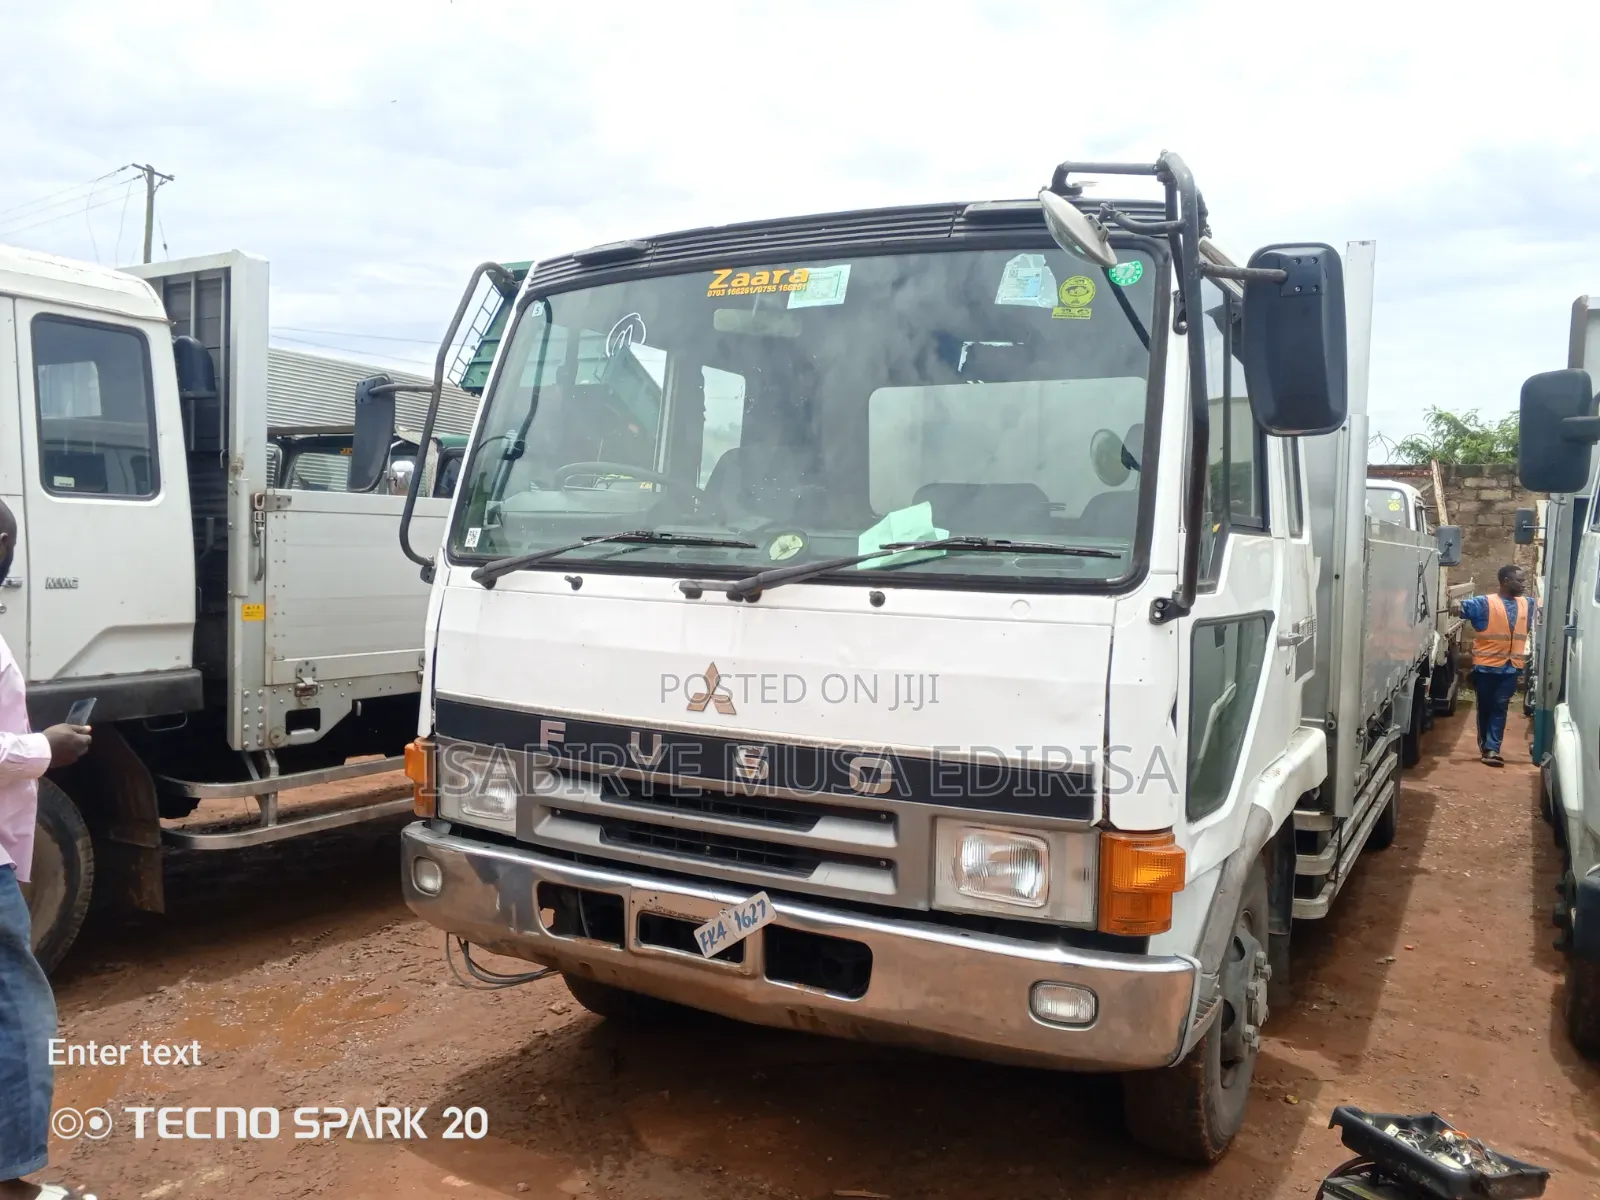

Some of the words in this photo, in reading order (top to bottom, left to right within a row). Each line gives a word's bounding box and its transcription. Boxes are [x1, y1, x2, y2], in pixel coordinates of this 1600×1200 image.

[707, 289, 725, 297] 0703
[709, 268, 809, 290] Zaara
[540, 720, 892, 795] FUSO
[734, 898, 766, 932] 1627
